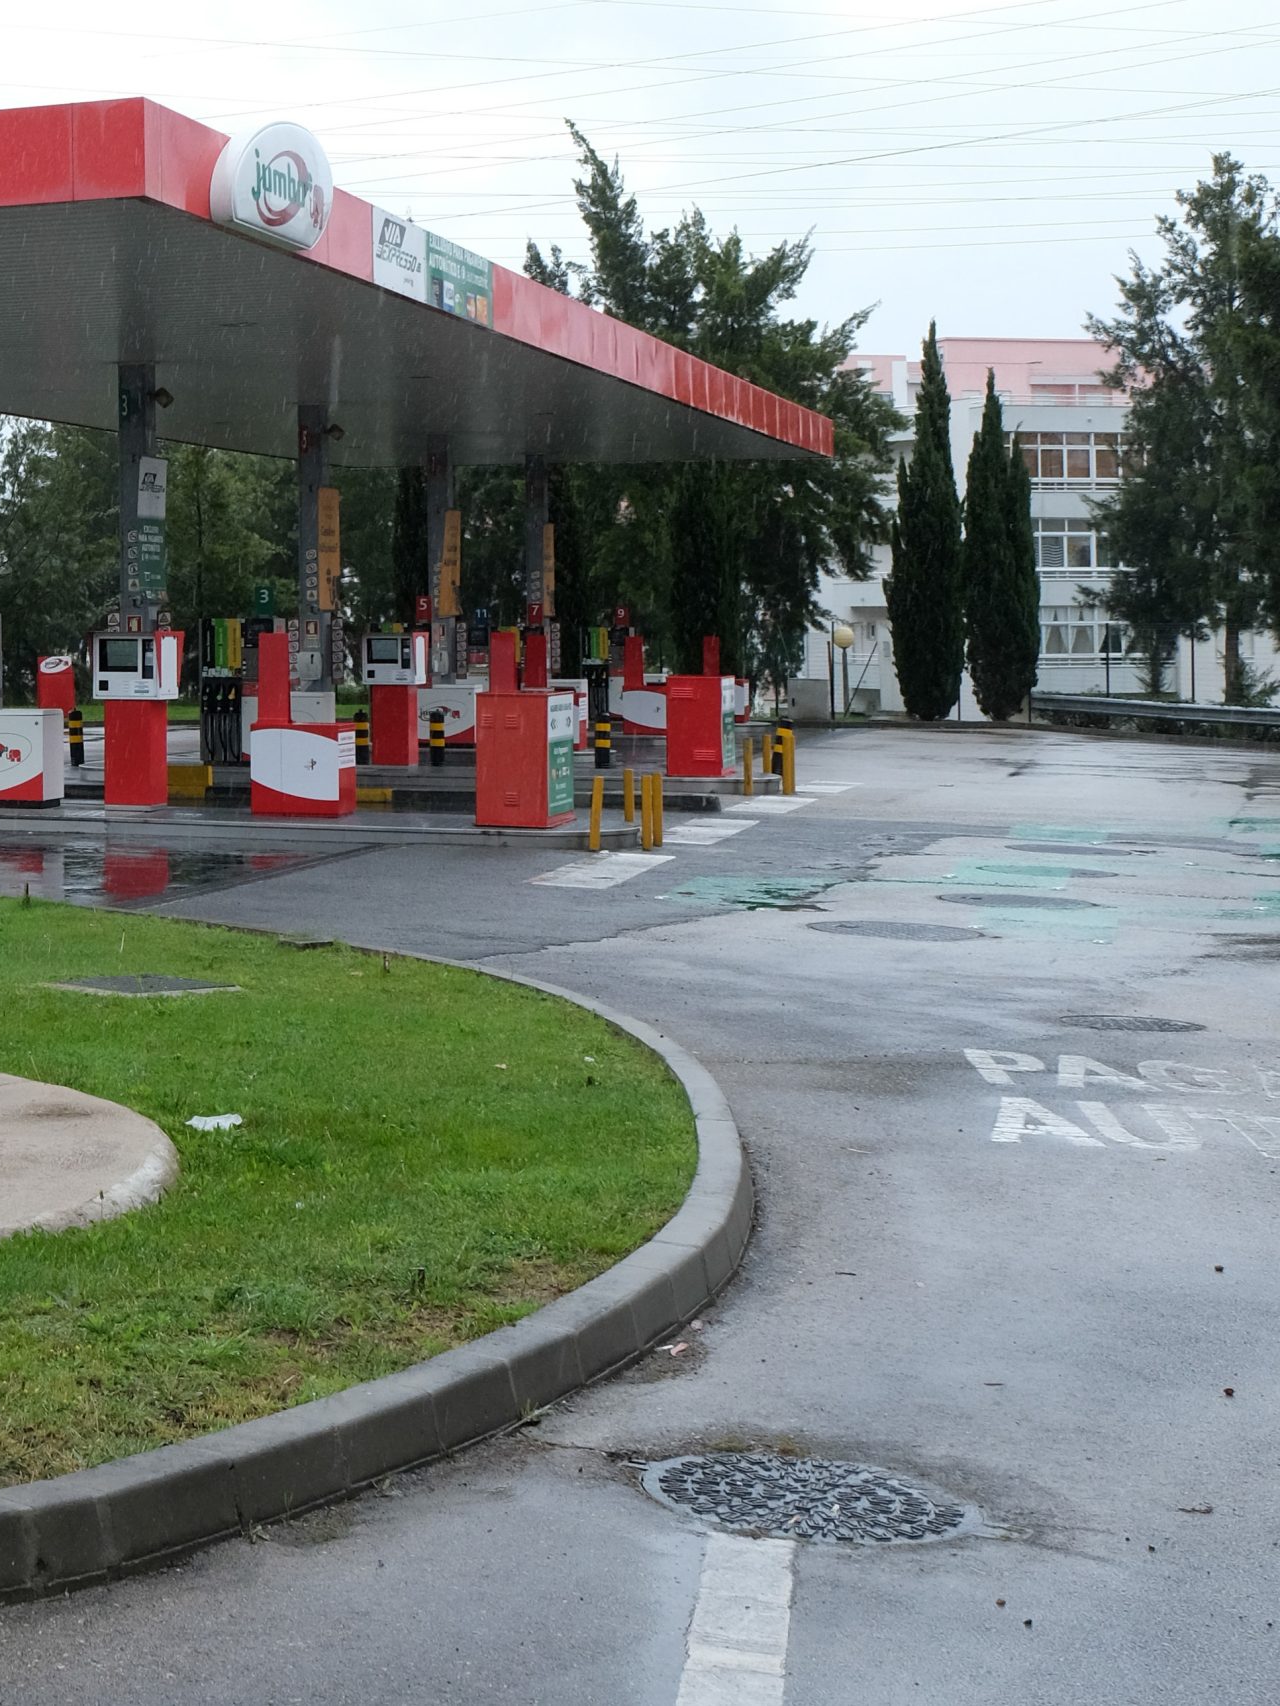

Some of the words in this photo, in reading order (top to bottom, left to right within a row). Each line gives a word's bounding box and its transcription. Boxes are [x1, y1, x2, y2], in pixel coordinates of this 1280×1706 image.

[251, 148, 308, 207] jumbo
[259, 589, 269, 603] 3
[419, 598, 428, 610] 5
[475, 609, 488, 618] 11
[531, 605, 540, 615] 7
[617, 608, 625, 618] 9
